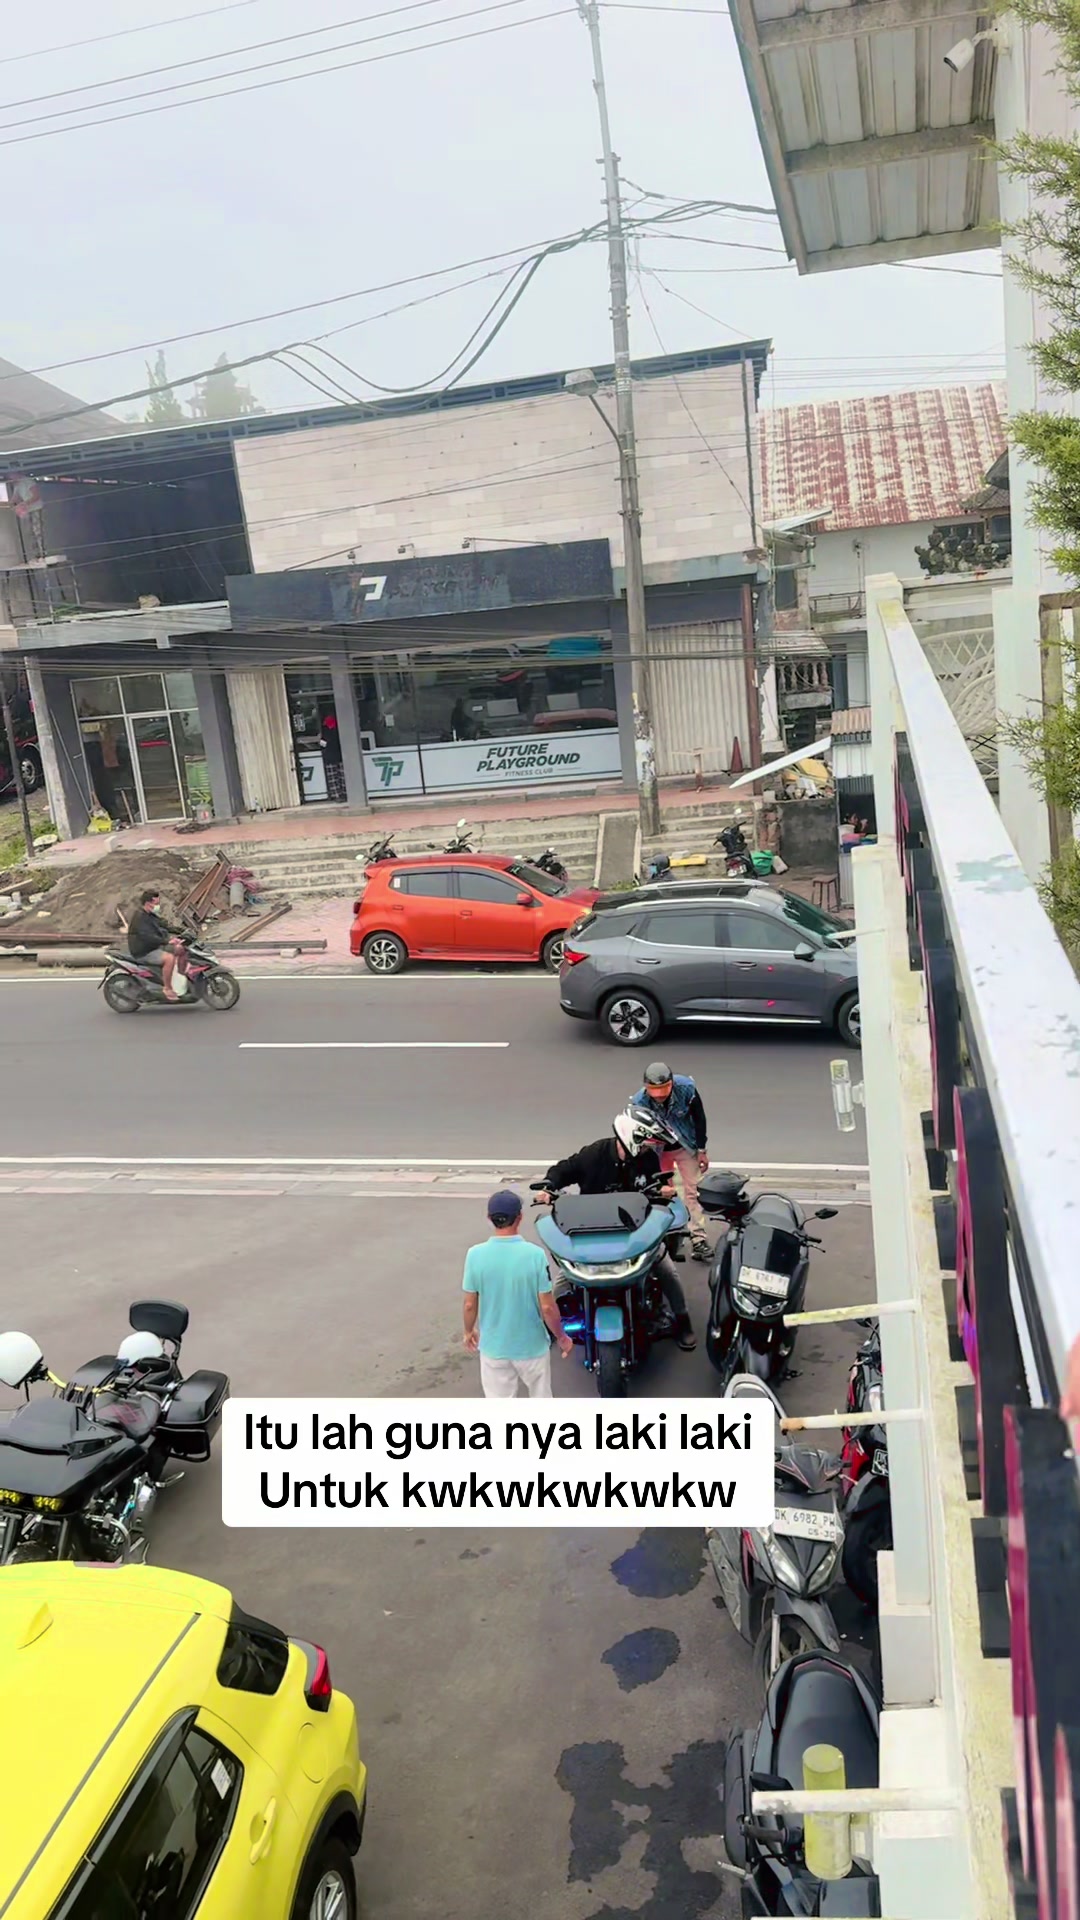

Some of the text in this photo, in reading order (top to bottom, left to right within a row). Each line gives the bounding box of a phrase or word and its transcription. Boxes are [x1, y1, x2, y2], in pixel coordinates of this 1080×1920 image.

[486, 743, 549, 759] FUTURE
[476, 753, 581, 772] PLAYGROUND
[505, 767, 554, 777] FITNESS CLUB
[774, 1509, 787, 1520] DK
[793, 1511, 818, 1525] 6982
